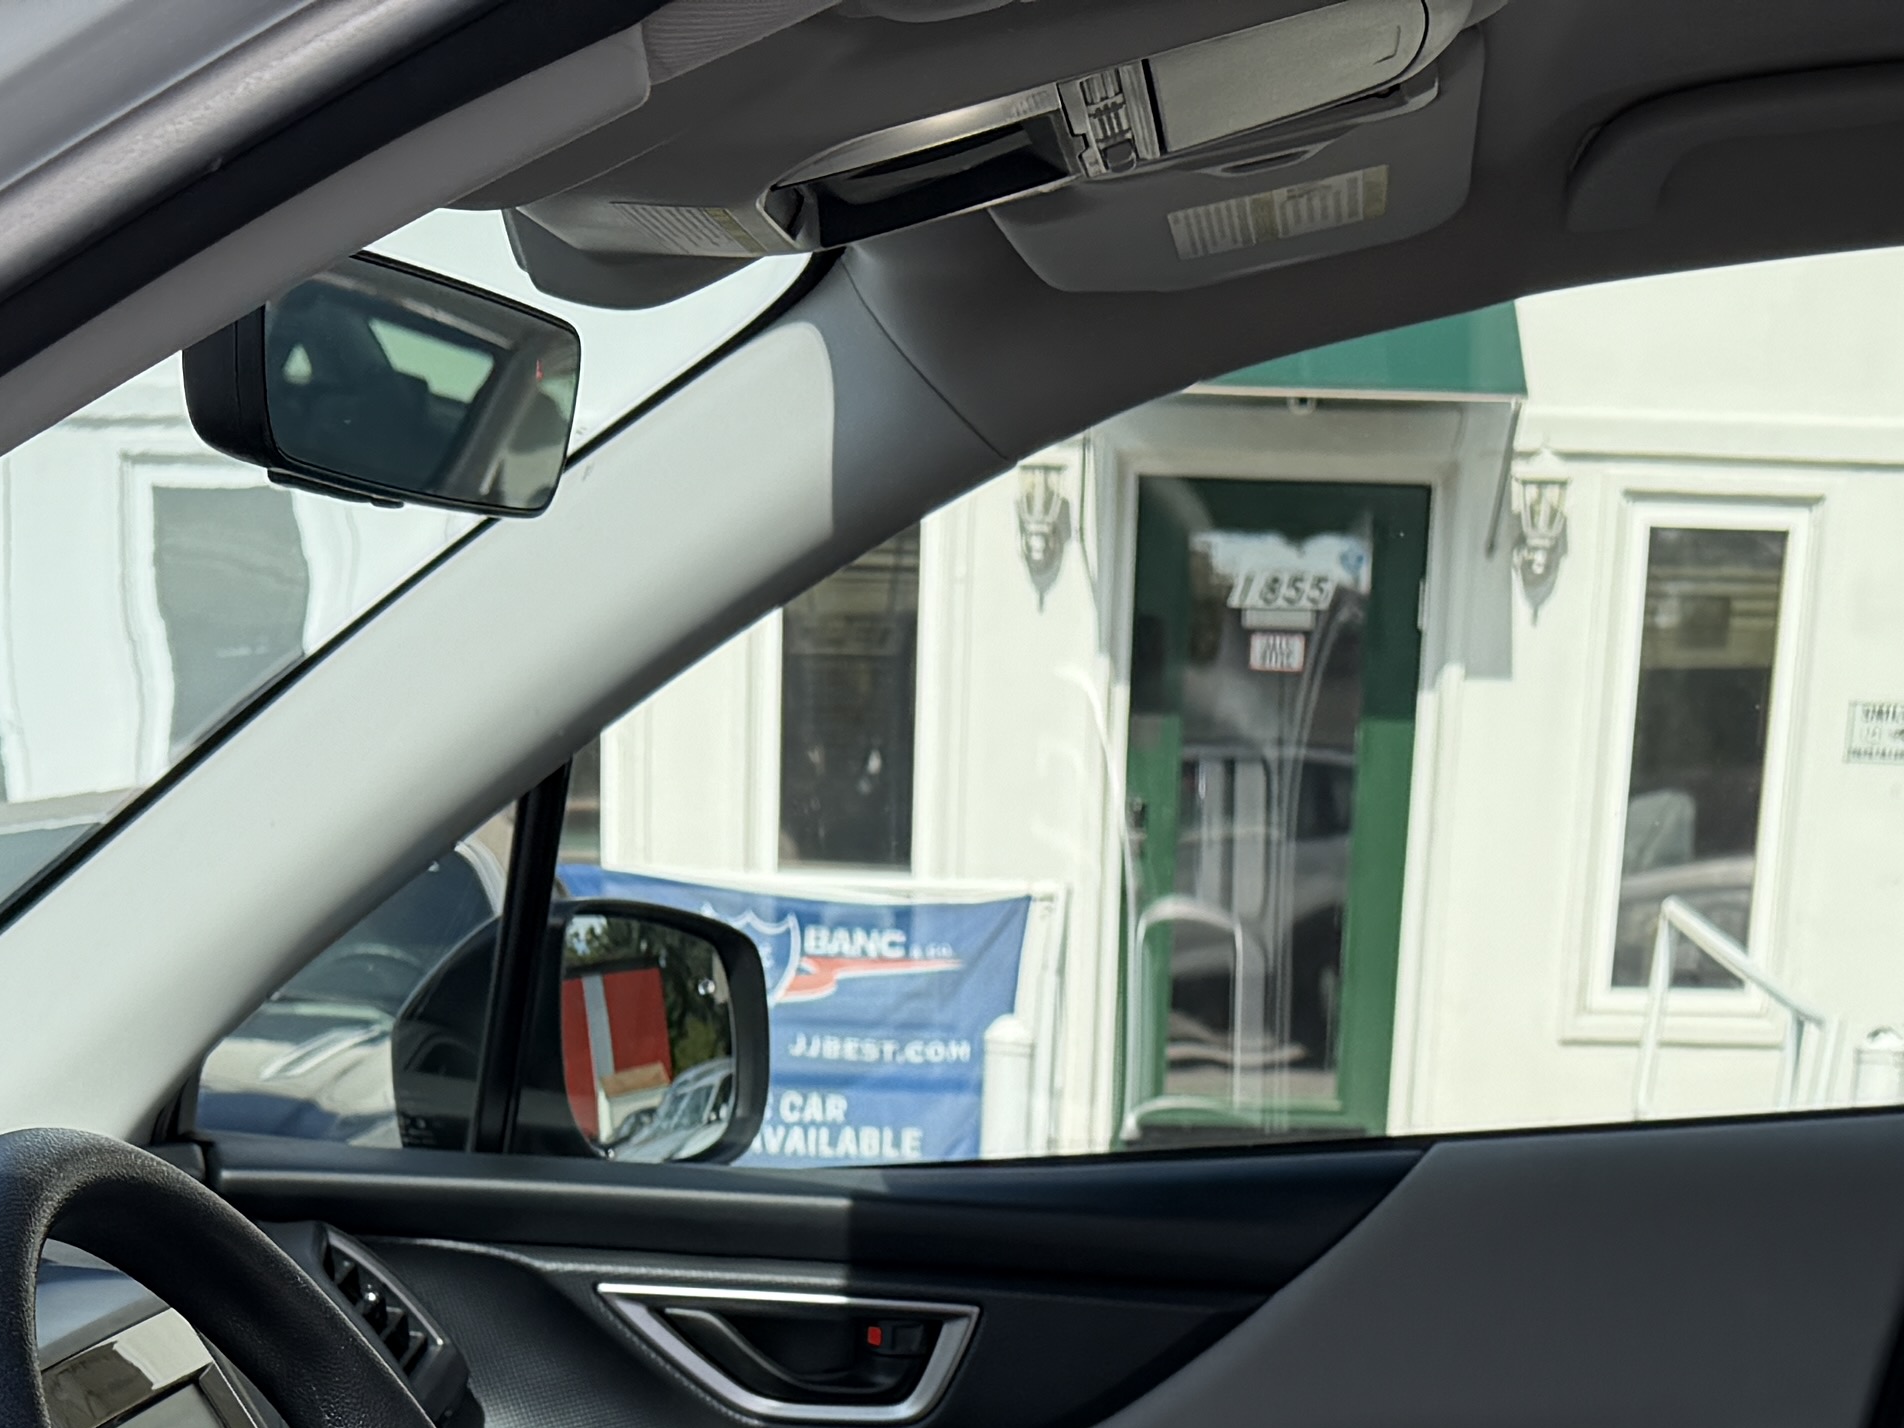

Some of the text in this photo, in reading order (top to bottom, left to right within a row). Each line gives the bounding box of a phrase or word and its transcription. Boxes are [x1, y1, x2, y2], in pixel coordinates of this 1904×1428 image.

[1237, 571, 1330, 605] 1855
[804, 924, 907, 958] BANC
[788, 1032, 972, 1064] JJBEST.COM
[779, 1090, 848, 1124] CAR
